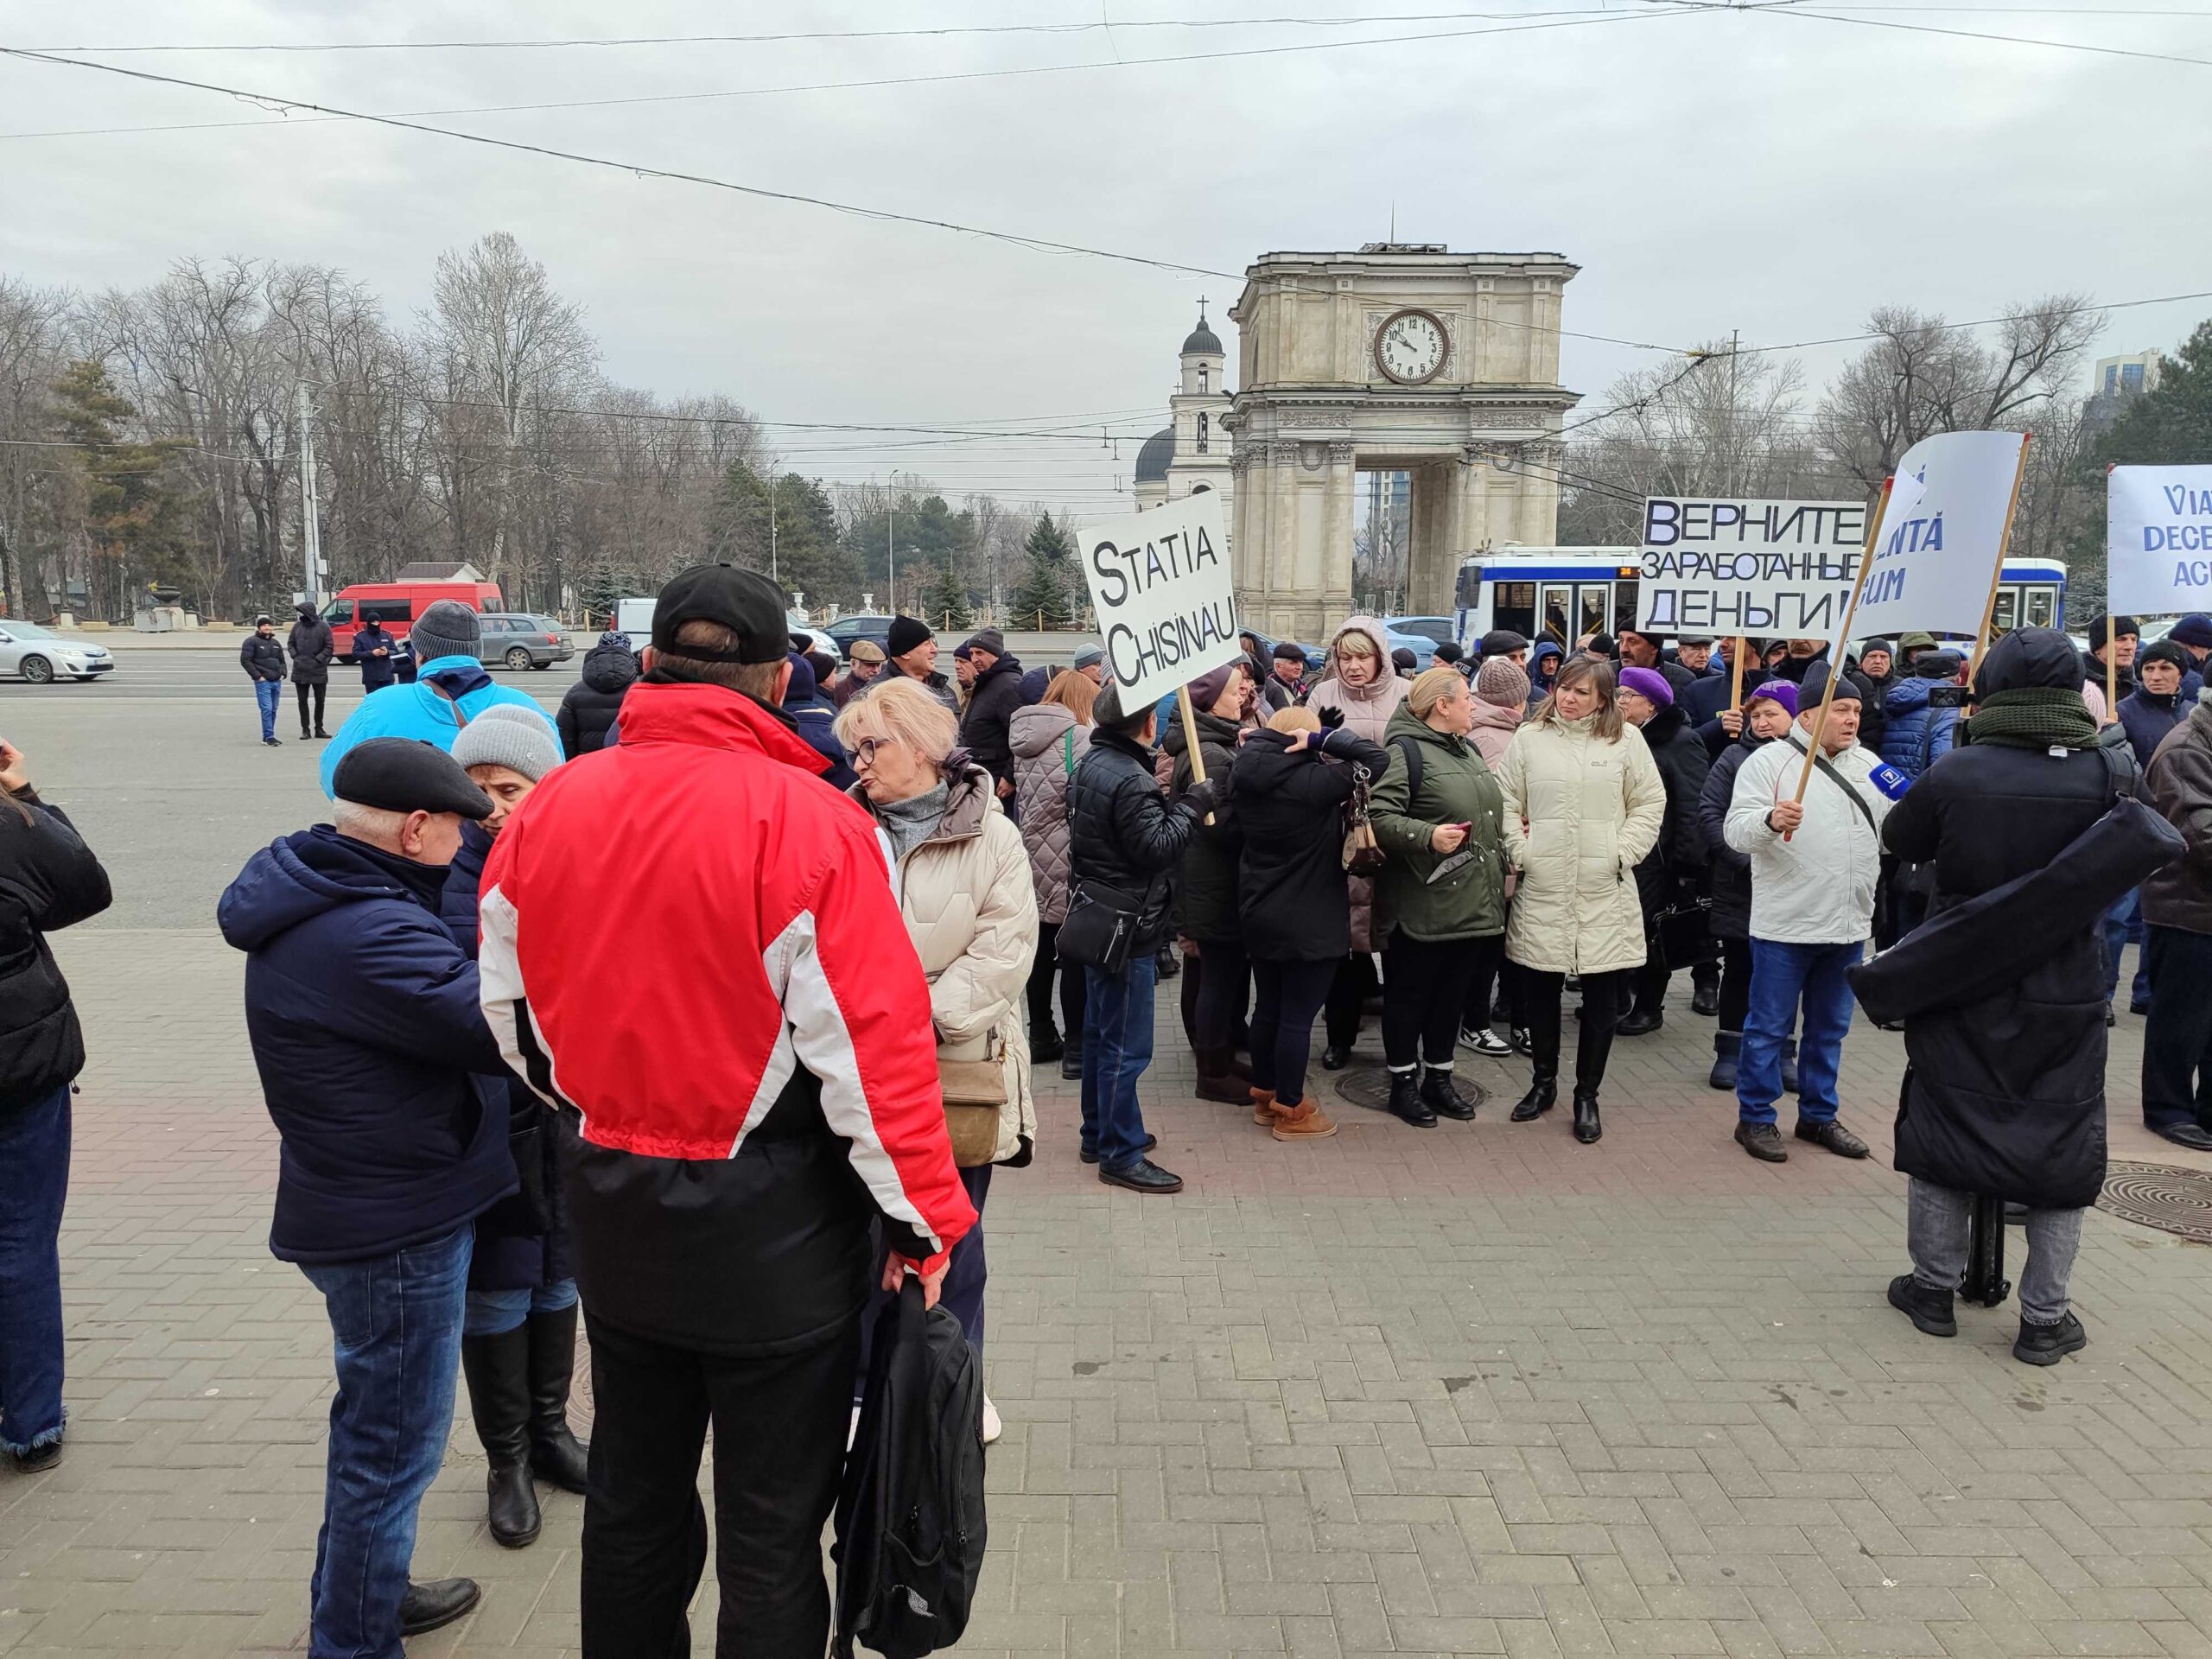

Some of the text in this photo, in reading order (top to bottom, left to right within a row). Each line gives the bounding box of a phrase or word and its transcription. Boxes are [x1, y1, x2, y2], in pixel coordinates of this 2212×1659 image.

[2164, 484, 2212, 515] VIA
[1643, 499, 1865, 546] ВЕРНИТЕ
[1876, 510, 1943, 561] NTĂ
[1641, 551, 1861, 581] ЗАРАБОТАННЫЕ
[2173, 561, 2212, 587] AC
